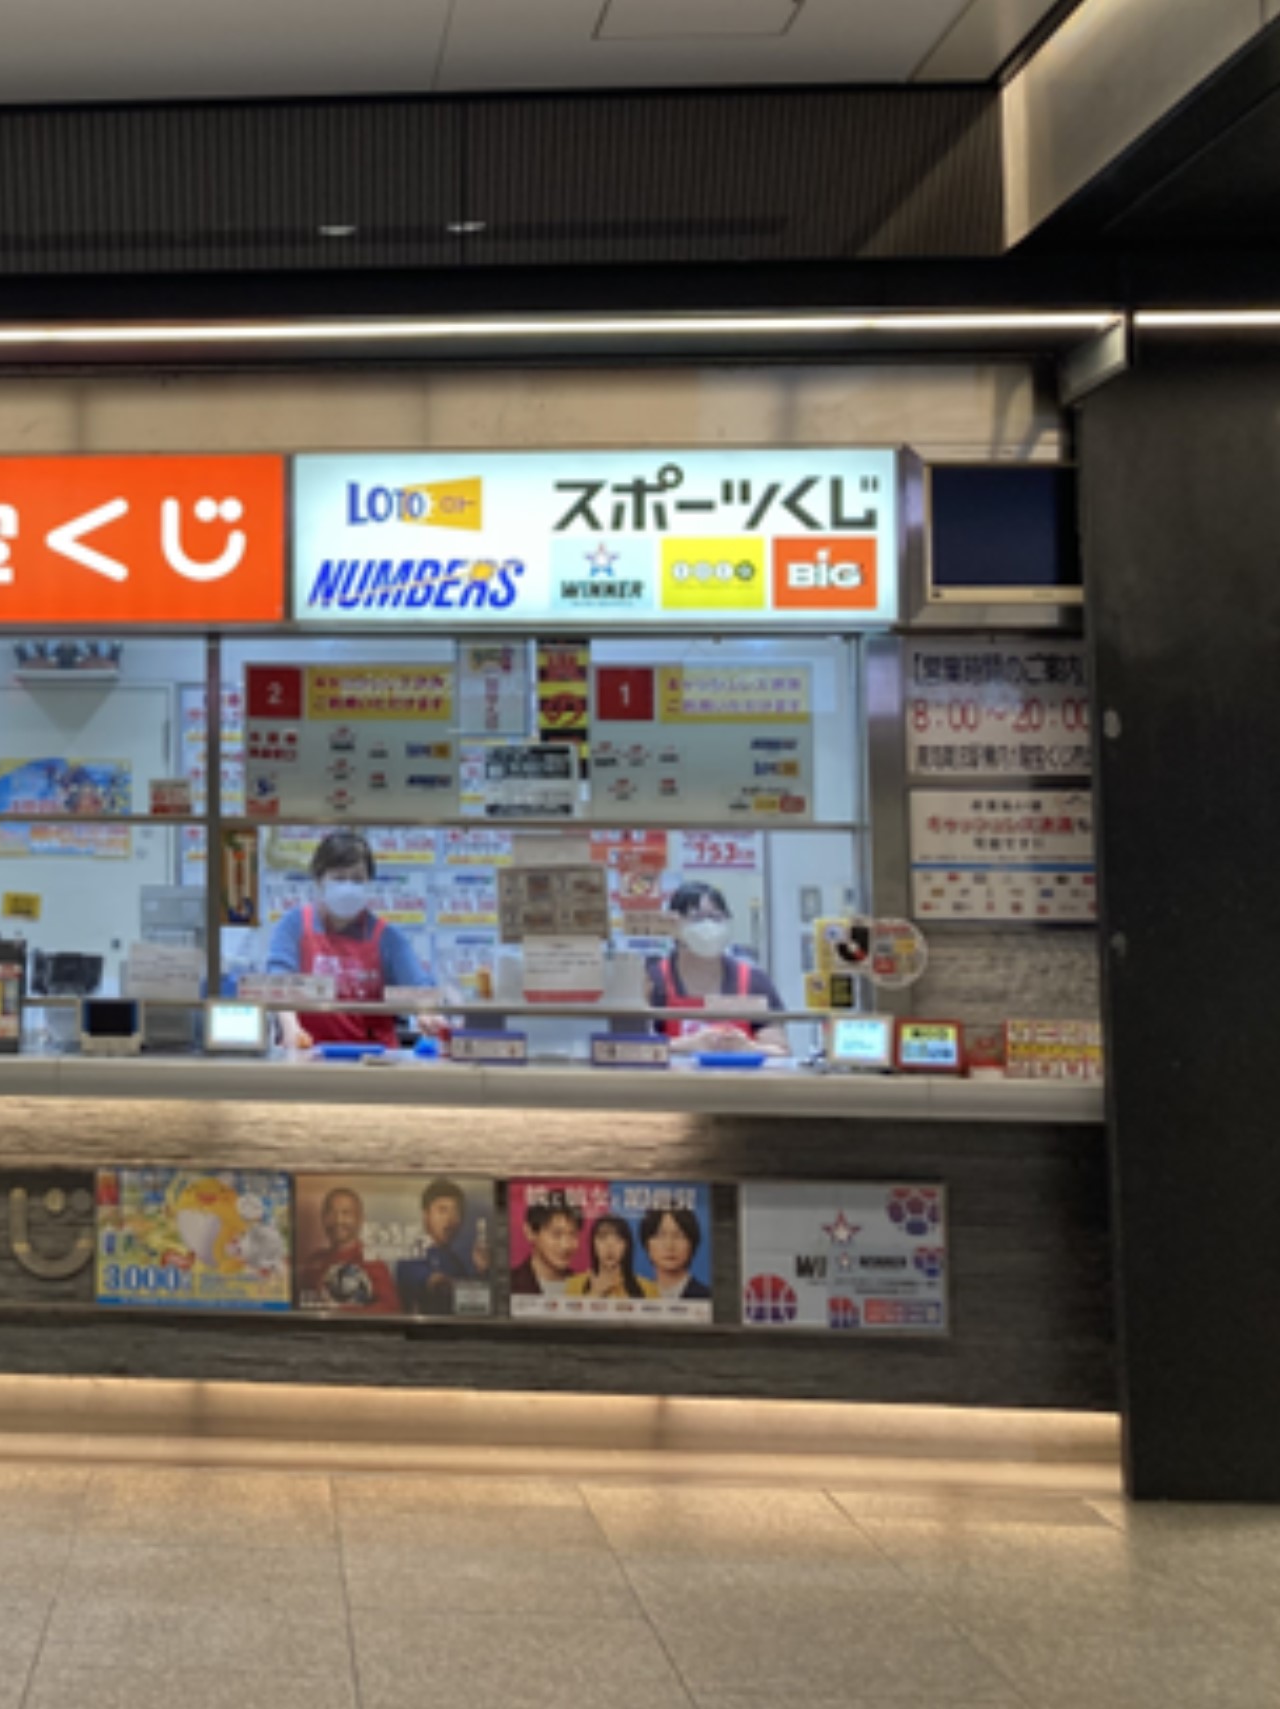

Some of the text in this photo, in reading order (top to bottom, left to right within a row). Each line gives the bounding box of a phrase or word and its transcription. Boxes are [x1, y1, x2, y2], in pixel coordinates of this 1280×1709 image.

[551, 462, 879, 531] スポーツくじ
[309, 559, 525, 608] NUMBERS
[266, 683, 283, 705] 2
[619, 683, 630, 706] 1
